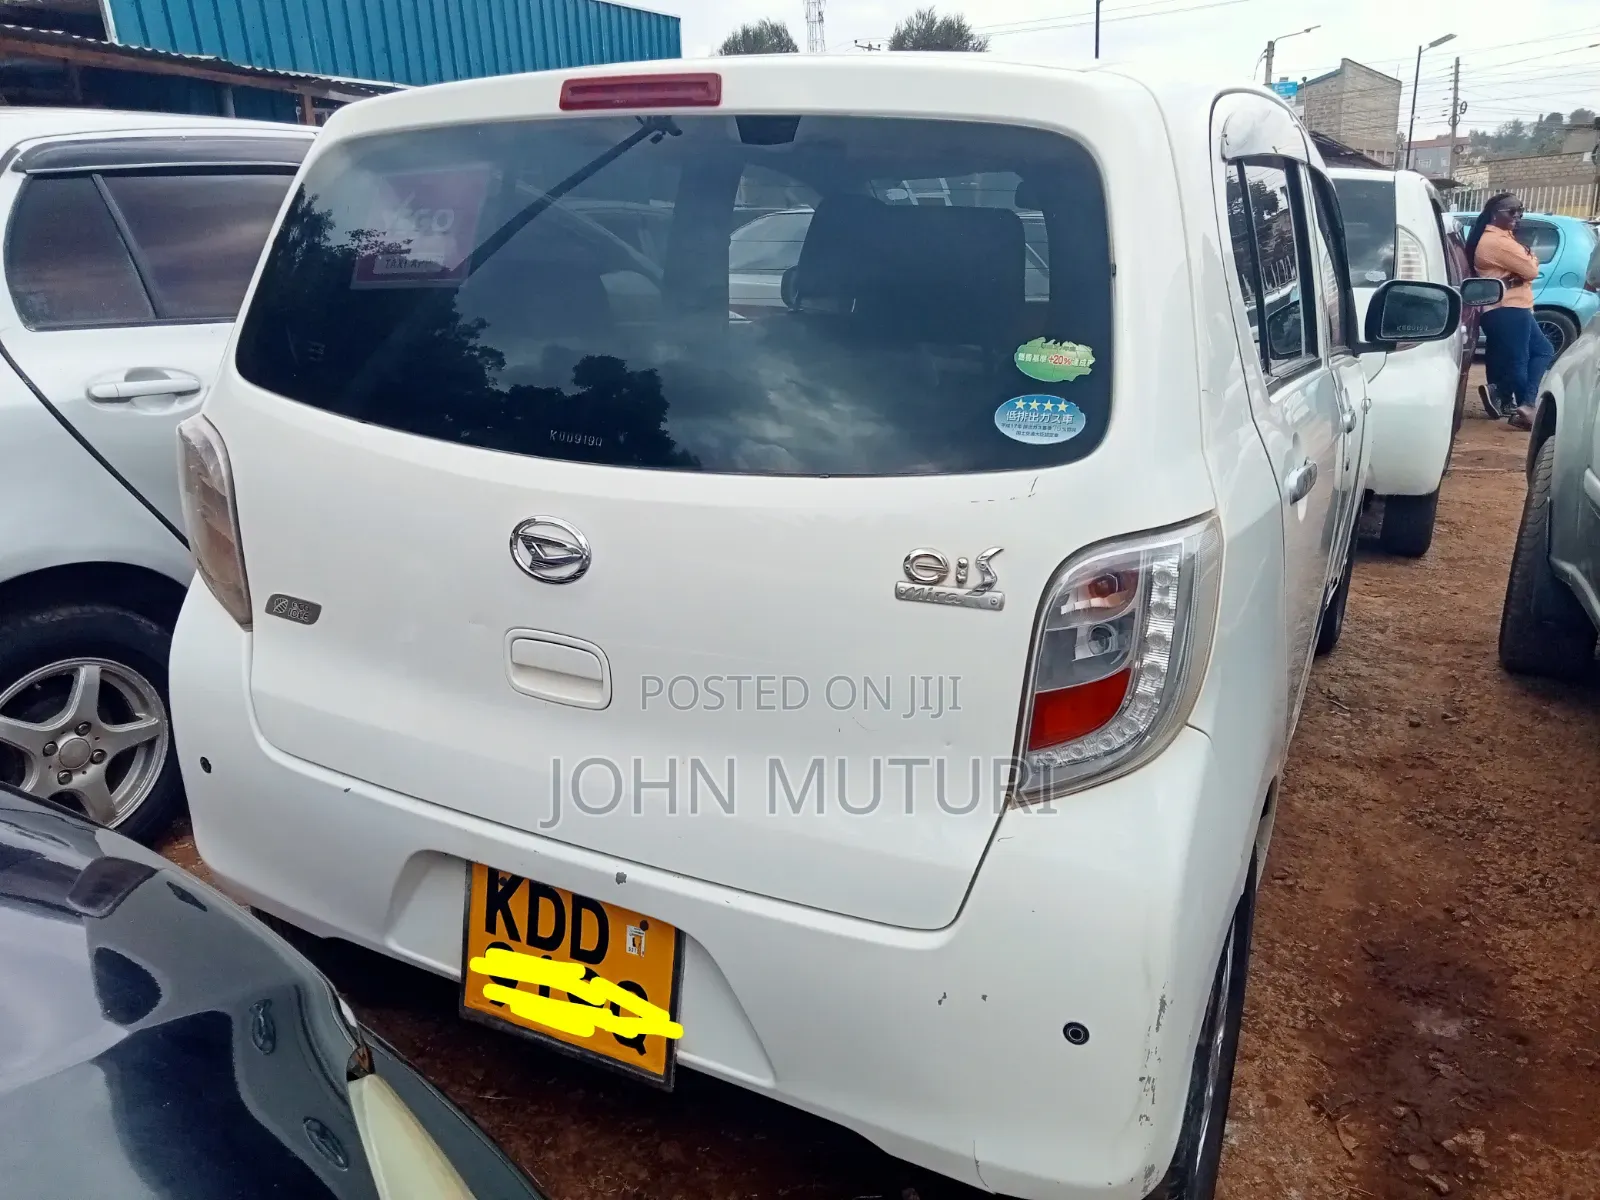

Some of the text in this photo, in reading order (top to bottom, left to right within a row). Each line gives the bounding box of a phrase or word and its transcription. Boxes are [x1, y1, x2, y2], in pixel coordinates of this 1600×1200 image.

[1006, 410, 1073, 425] 低排出ガス車
[901, 587, 965, 605] Mira
[484, 867, 610, 965] KDD
